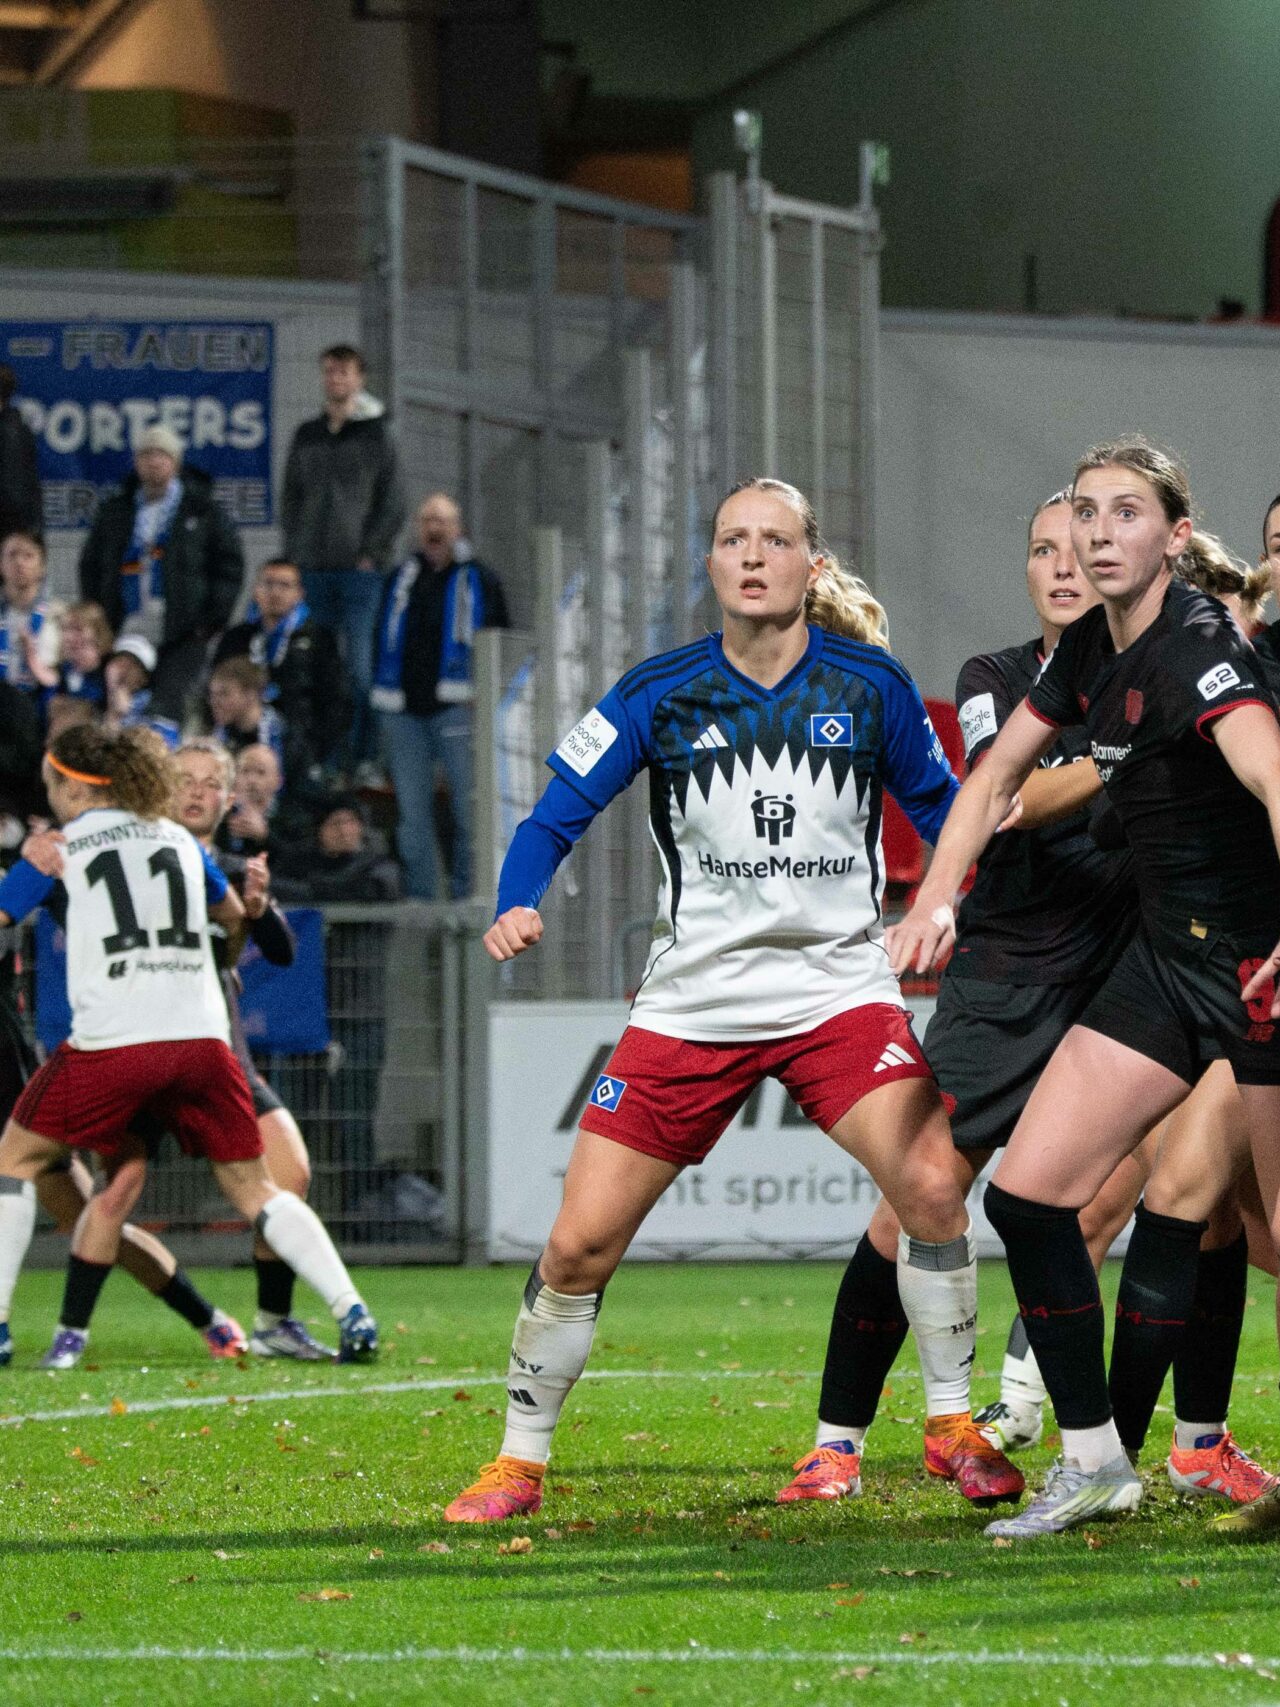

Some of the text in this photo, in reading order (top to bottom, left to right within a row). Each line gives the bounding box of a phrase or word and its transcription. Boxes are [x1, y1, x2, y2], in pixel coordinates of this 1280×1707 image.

[62, 327, 268, 370] FRAUEN
[698, 850, 856, 879] HanseMerkur
[84, 846, 201, 955] 11
[724, 1162, 880, 1213] sprich
